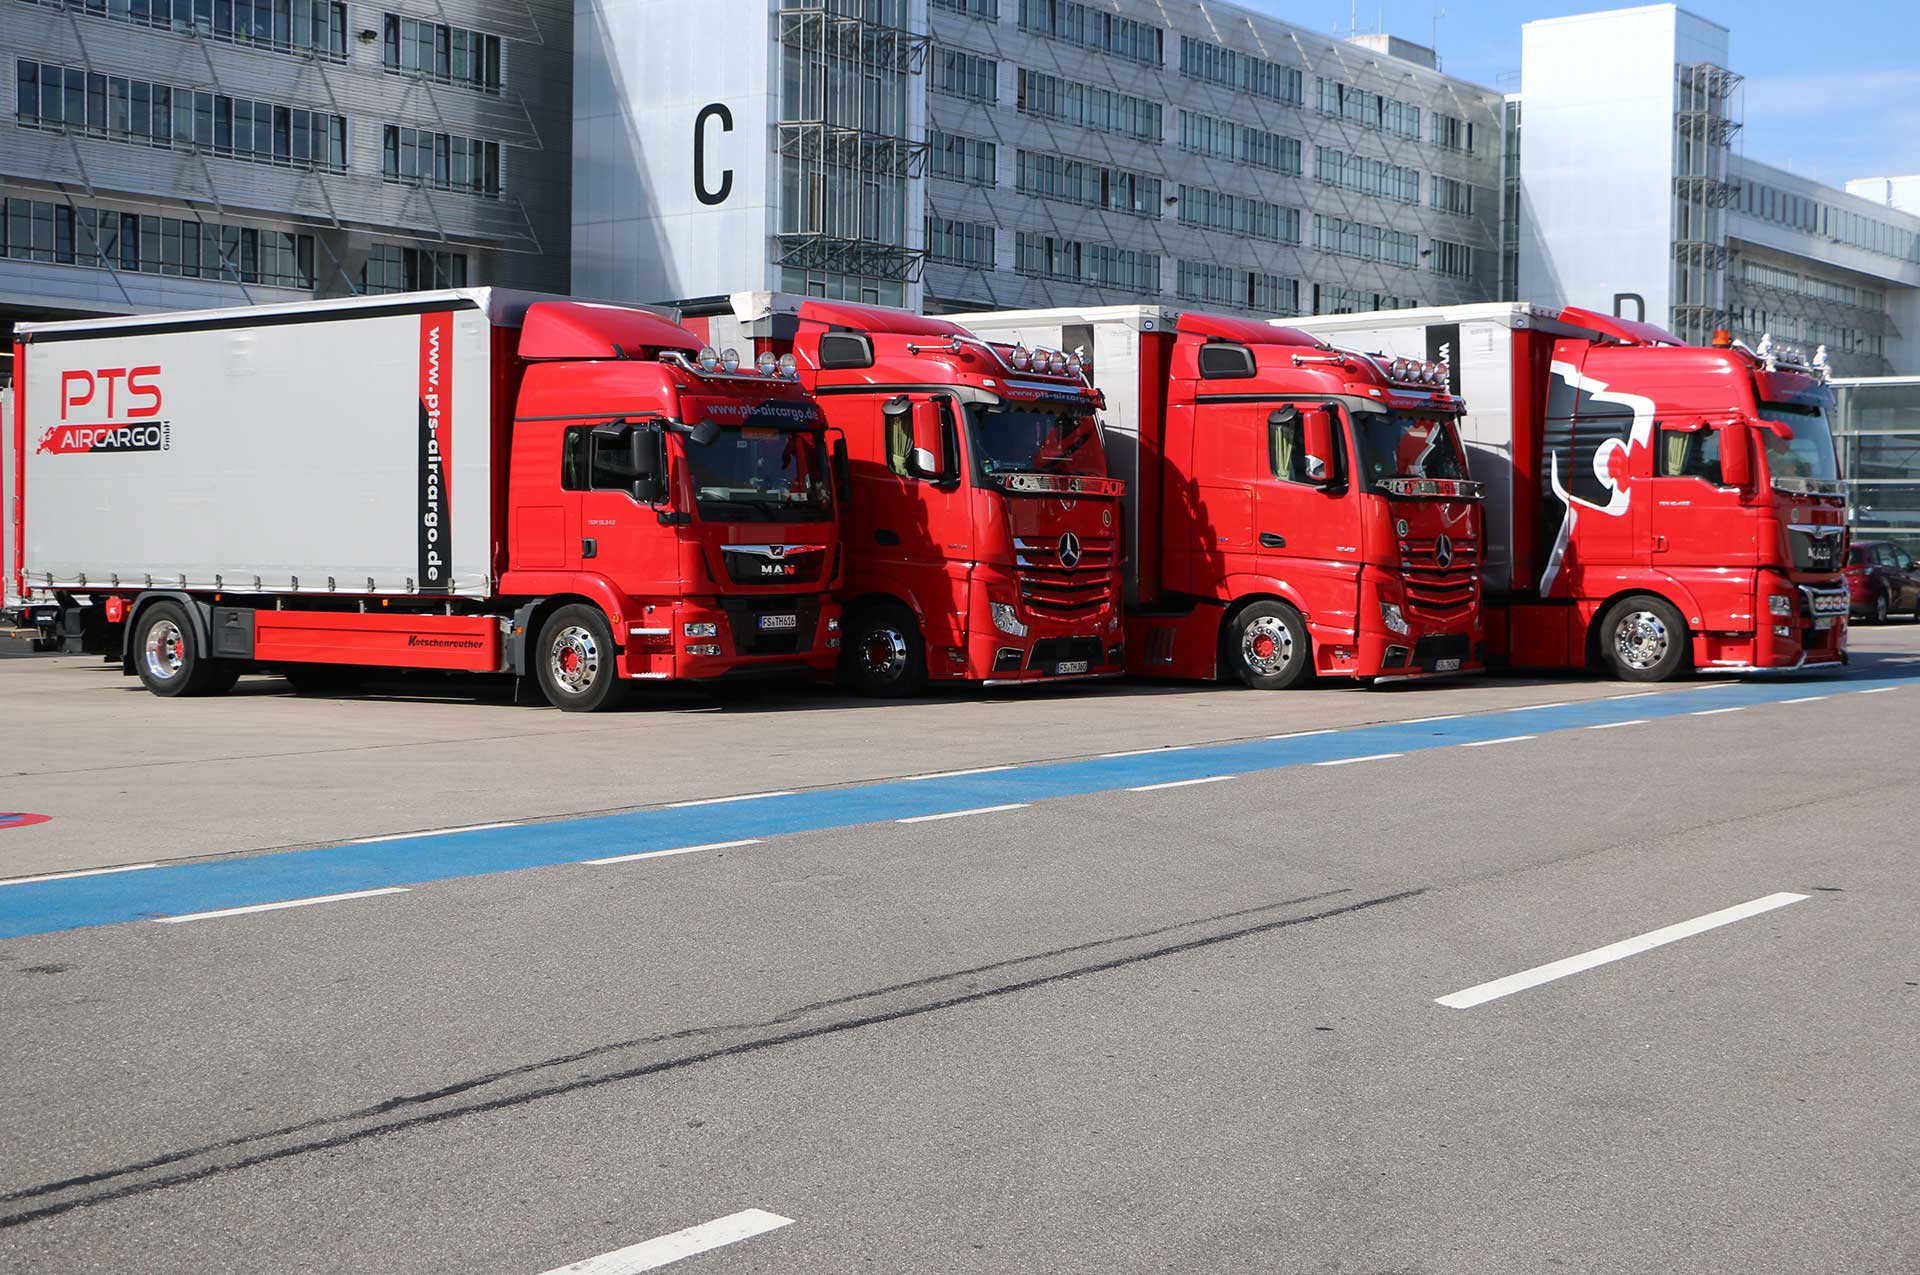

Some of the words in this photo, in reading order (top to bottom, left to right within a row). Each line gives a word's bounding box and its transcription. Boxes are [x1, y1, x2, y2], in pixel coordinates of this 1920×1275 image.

[694, 103, 733, 205] C
[61, 366, 162, 420] PTS
[707, 404, 819, 420] www.pts-aircargo.de
[61, 427, 161, 448] AIRCARGO
[163, 420, 171, 451] GmbH
[424, 326, 442, 581] www.pts-aircargo.de
[761, 565, 795, 575] MAN
[408, 635, 483, 648] Kotschenreuther
